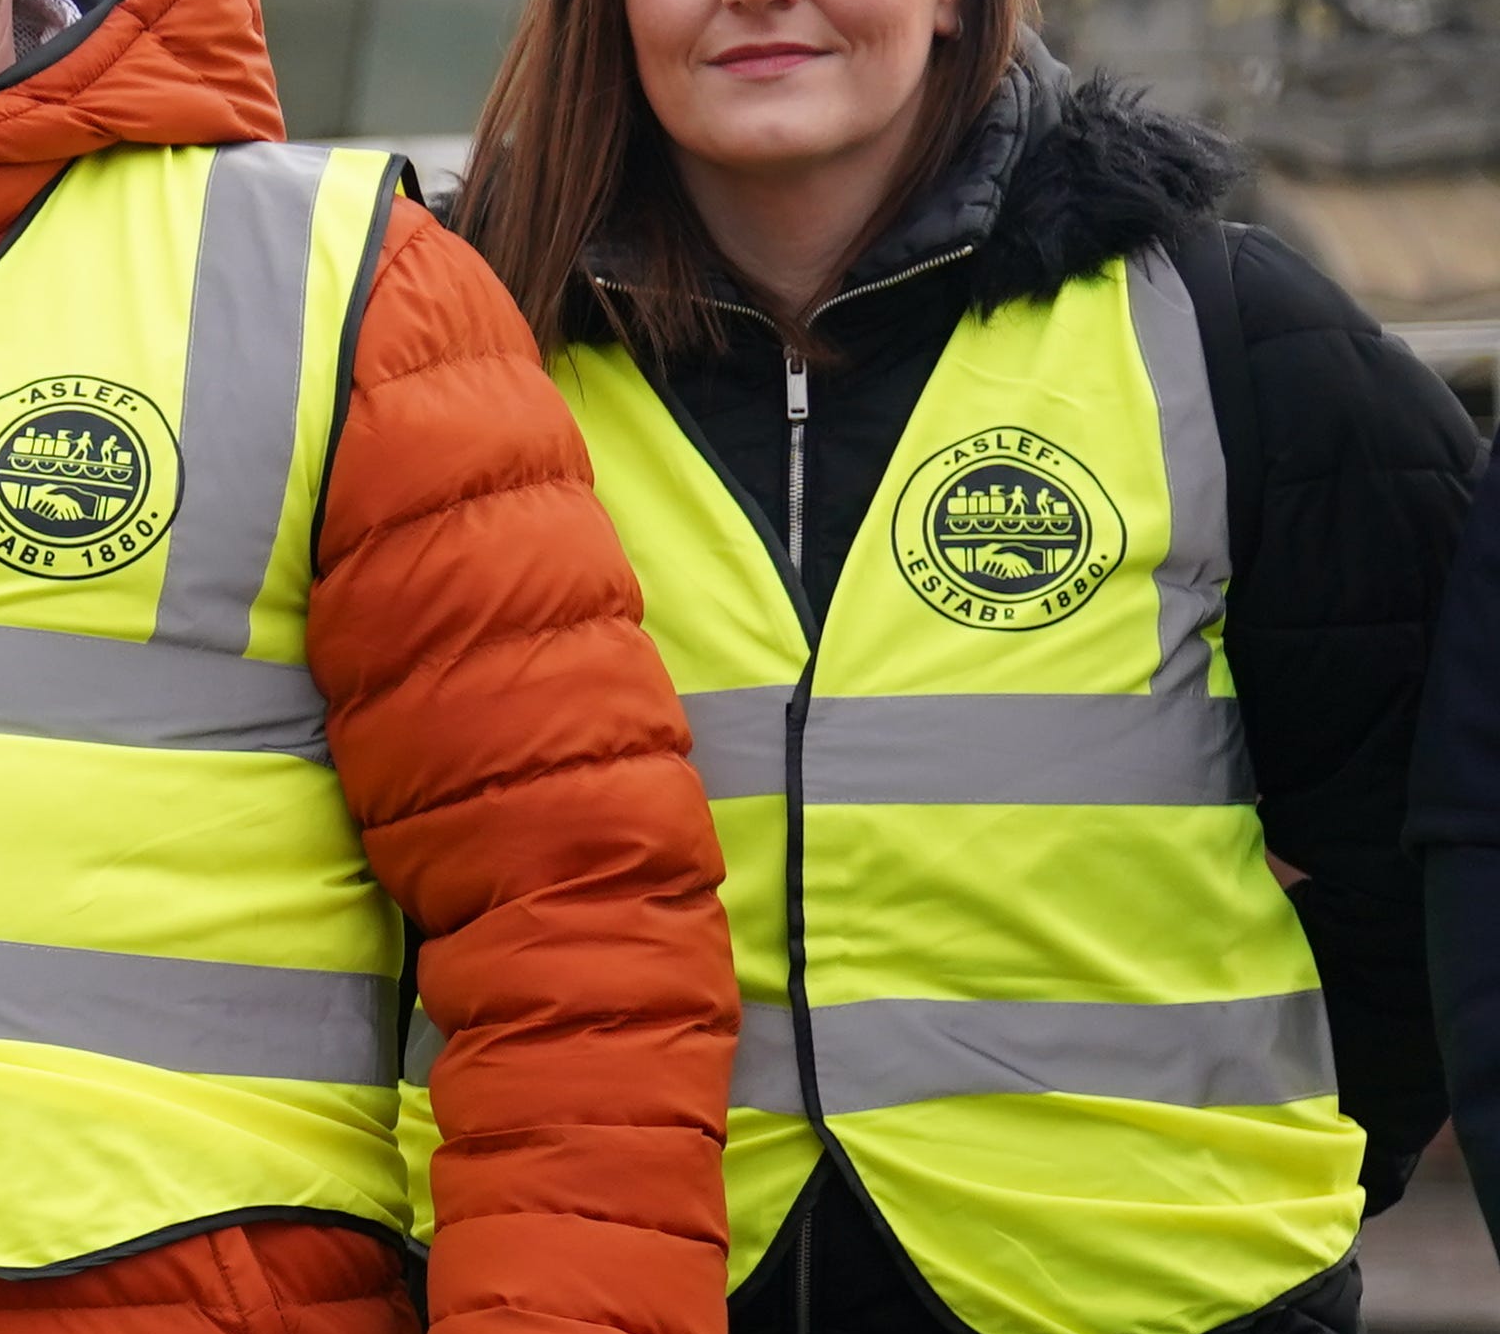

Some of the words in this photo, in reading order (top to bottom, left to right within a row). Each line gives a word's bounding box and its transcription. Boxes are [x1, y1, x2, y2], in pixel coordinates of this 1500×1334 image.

[30, 381, 134, 413] ASLEF
[952, 433, 1055, 464] ASLEF
[81, 519, 155, 568] 1880
[1040, 563, 1104, 616] 1880
